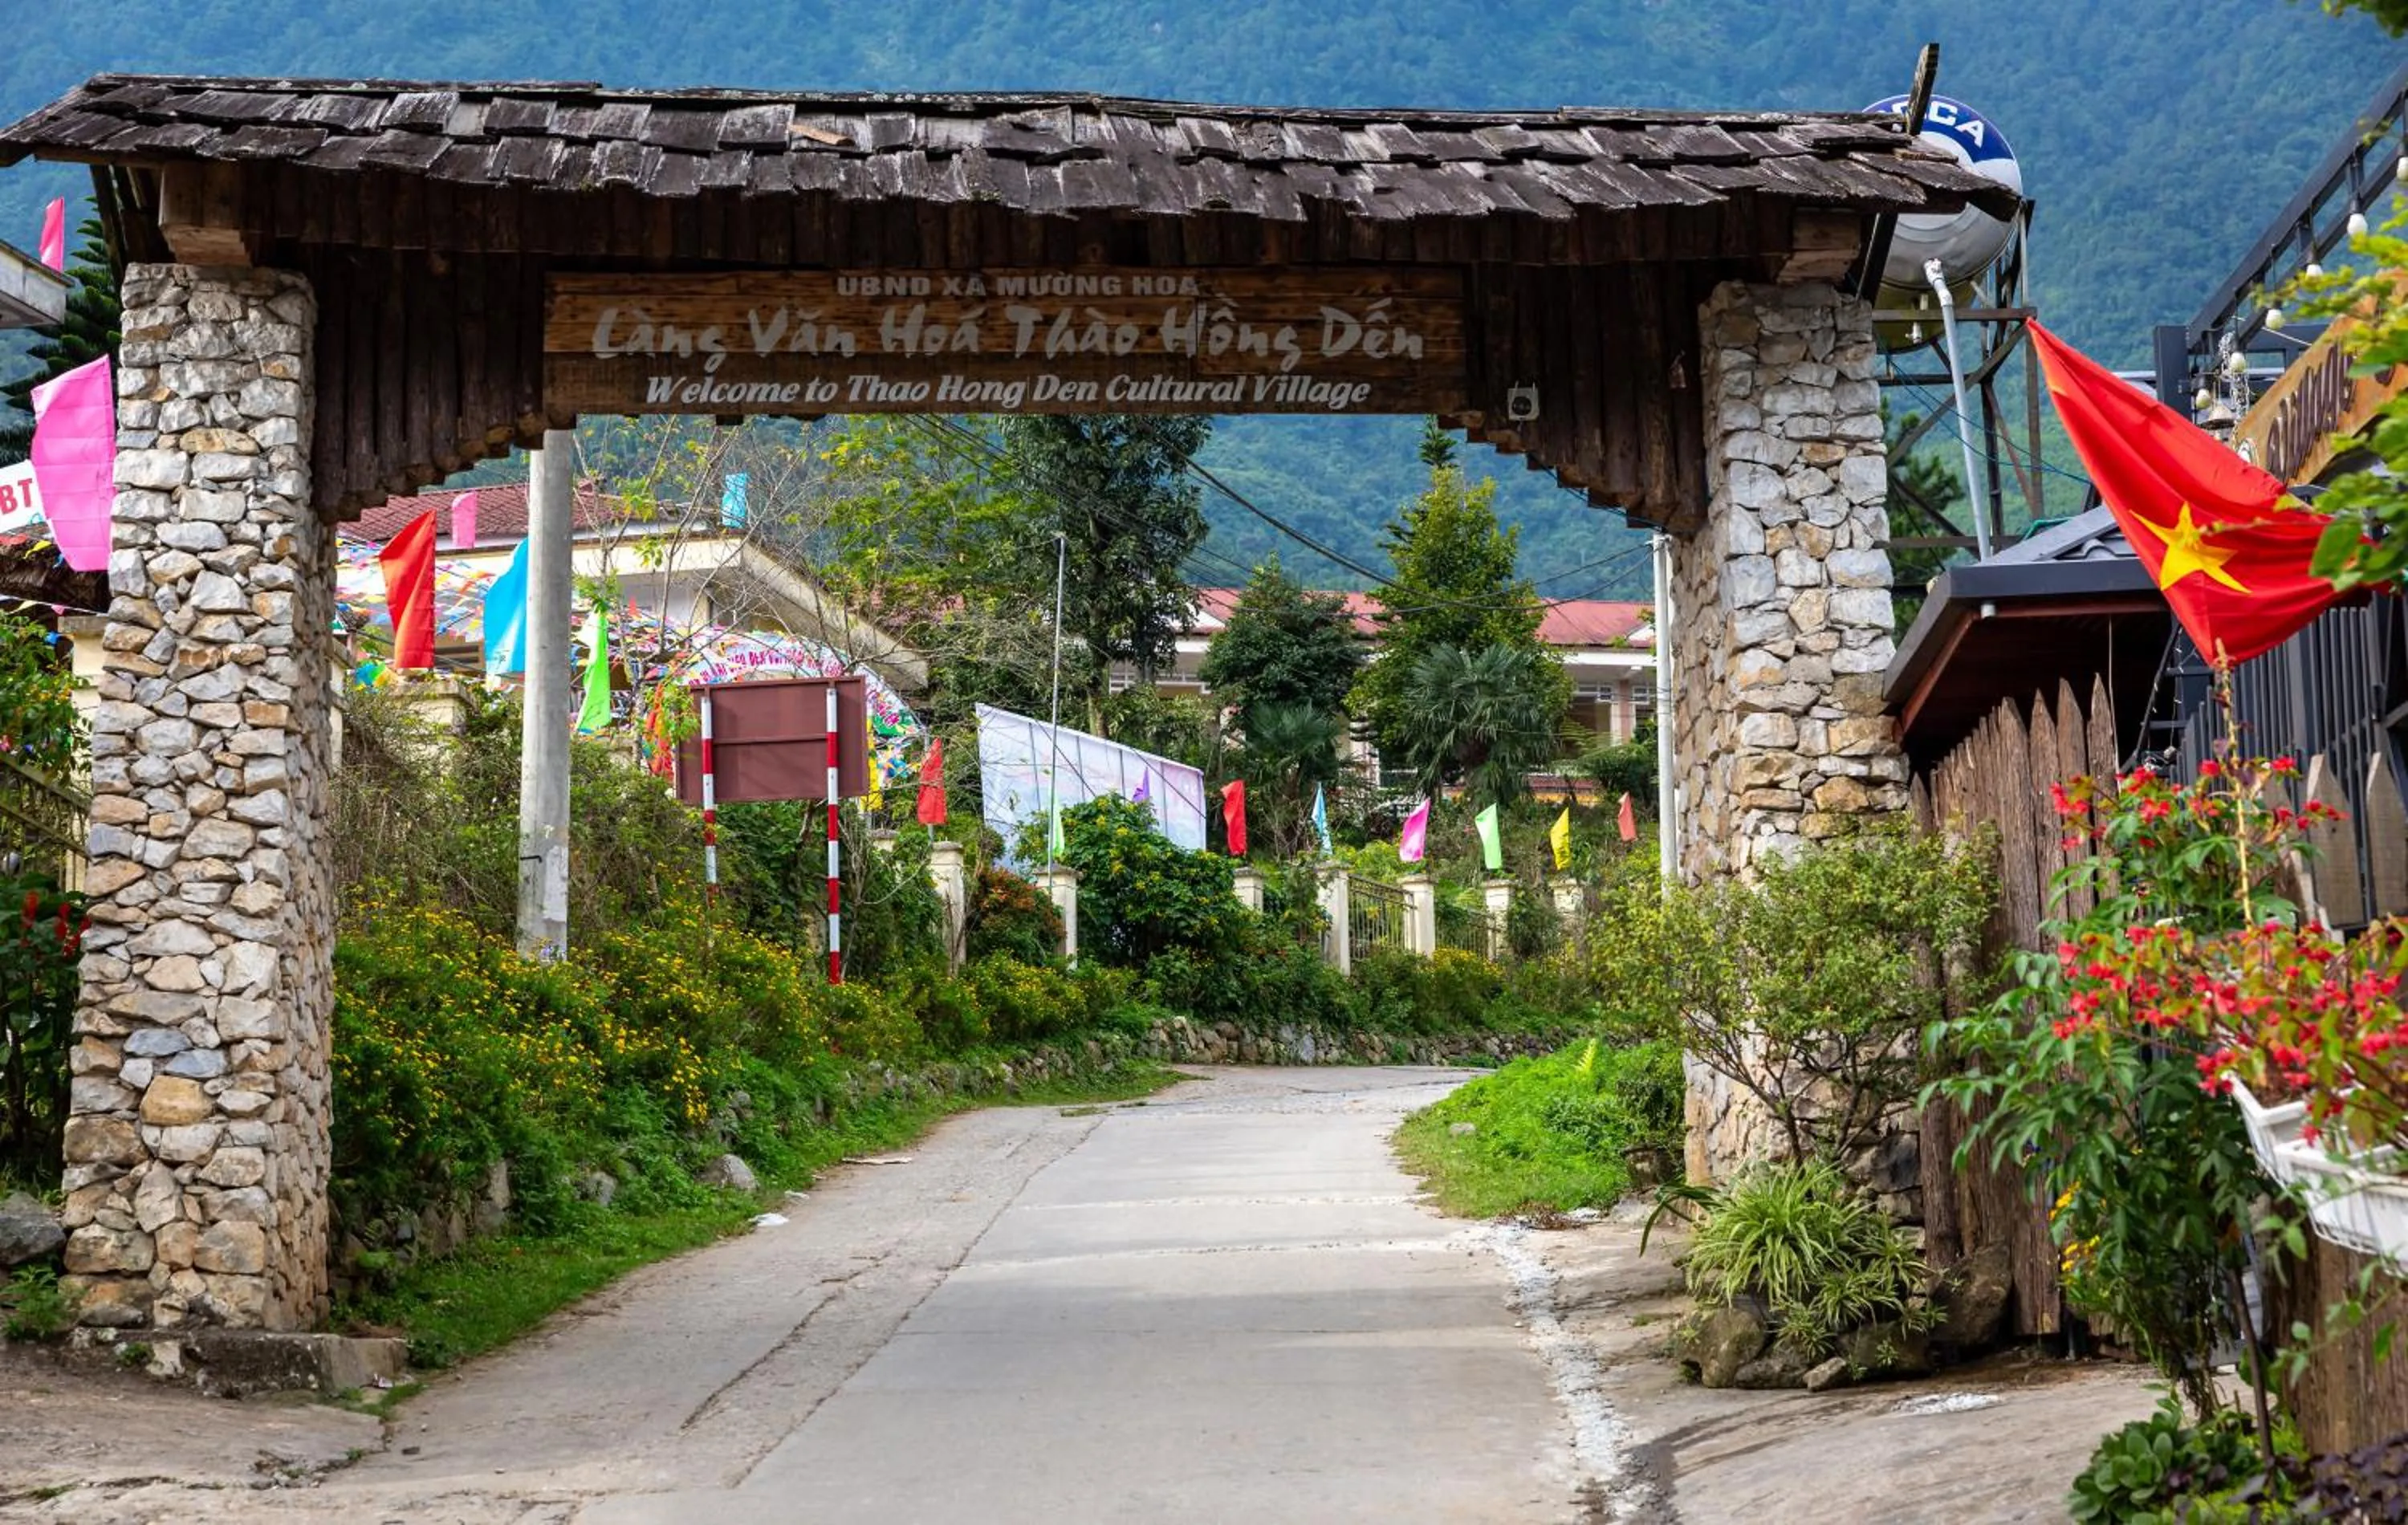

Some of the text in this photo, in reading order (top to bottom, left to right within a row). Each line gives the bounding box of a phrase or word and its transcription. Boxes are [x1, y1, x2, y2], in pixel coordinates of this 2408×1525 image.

[837, 276, 931, 296] UBND
[747, 304, 856, 357] Văn
[878, 303, 988, 359] Hoá
[1005, 306, 1140, 360] Thào
[1158, 292, 1303, 372] Hồng
[1320, 297, 1423, 360] Dến
[647, 372, 1372, 409] Welcome to Thao Hong Den Cultural Village
